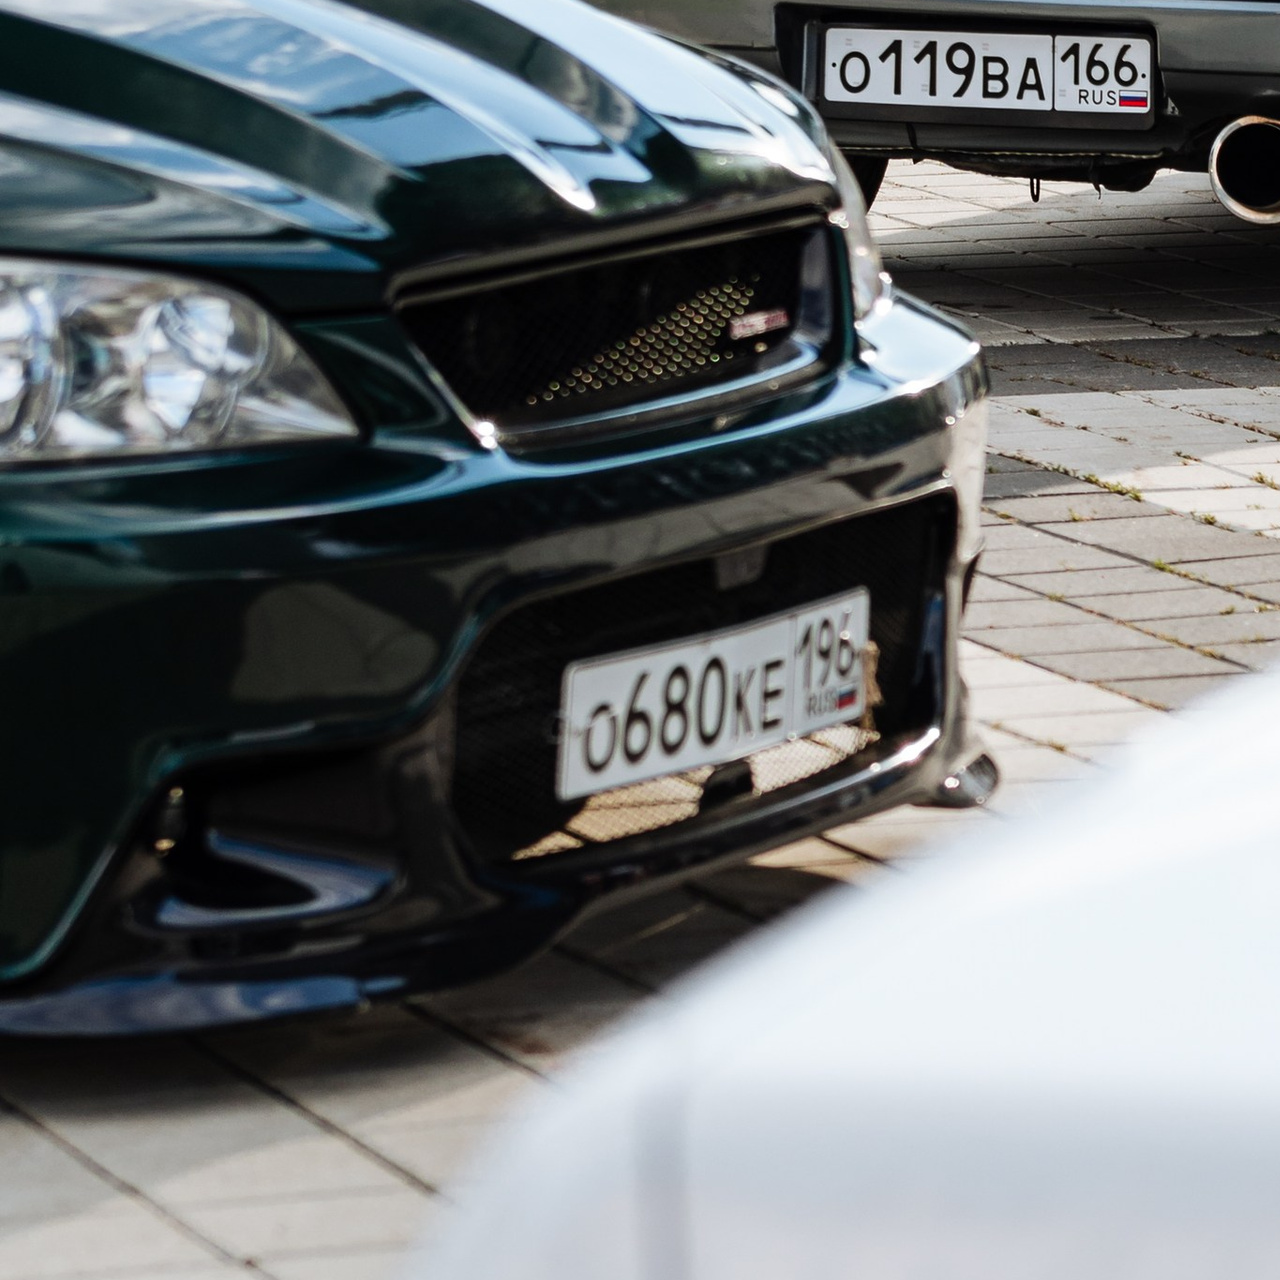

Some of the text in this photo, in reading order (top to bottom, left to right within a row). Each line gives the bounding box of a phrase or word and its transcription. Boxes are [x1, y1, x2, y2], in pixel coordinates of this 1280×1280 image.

[1060, 42, 1139, 87] 166
[1078, 89, 1117, 106] RUS
[798, 611, 856, 691] 196
[806, 687, 838, 717] RUS
